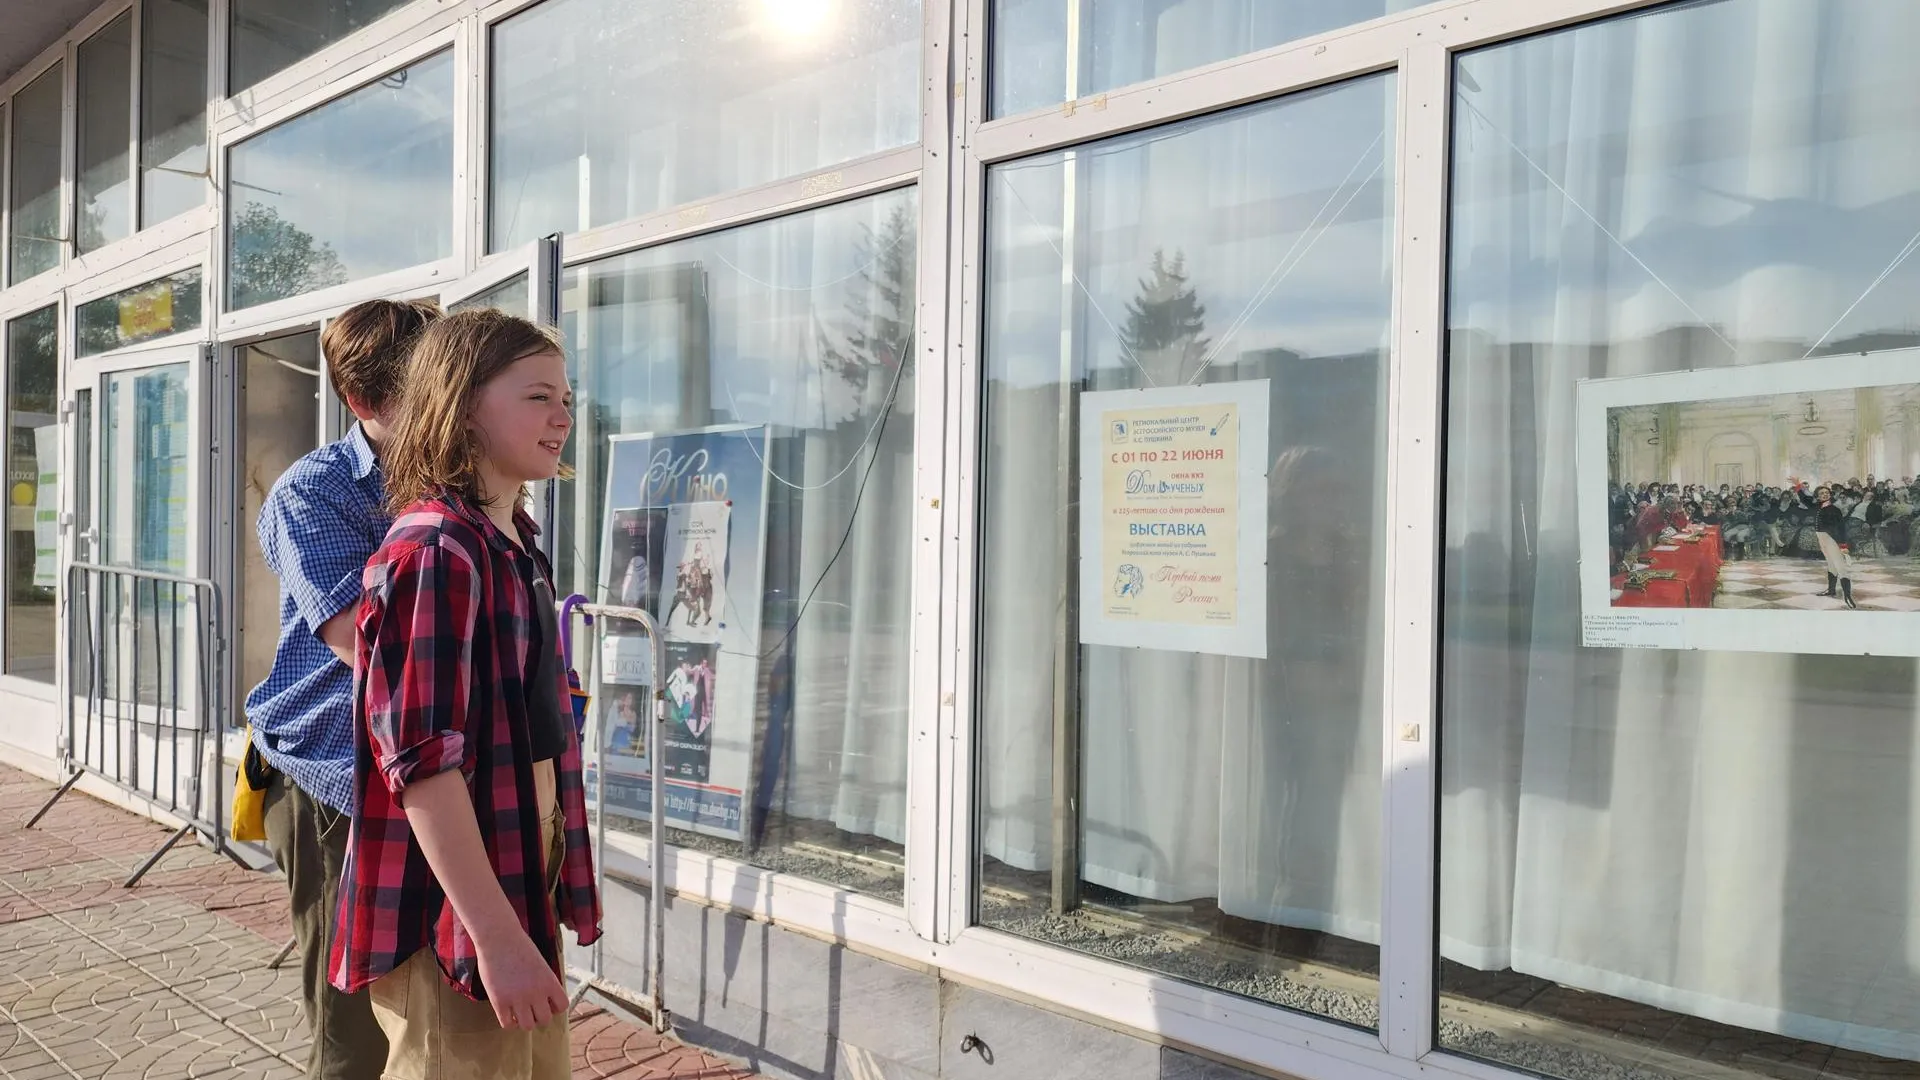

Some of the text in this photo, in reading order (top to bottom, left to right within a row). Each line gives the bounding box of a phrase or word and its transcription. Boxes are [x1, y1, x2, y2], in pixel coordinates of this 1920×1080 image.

[1132, 416, 1199, 426] РЕГИОНАЛЬНЫЙ ЦЕНТР
[1111, 449, 1224, 463] С 01 ПО 22 ИЮНЯ
[1169, 506, 1182, 514] дня
[1184, 506, 1225, 515] рождения
[1129, 523, 1207, 536] ВЫСТАВКА
[609, 659, 648, 673] ТОСКА
